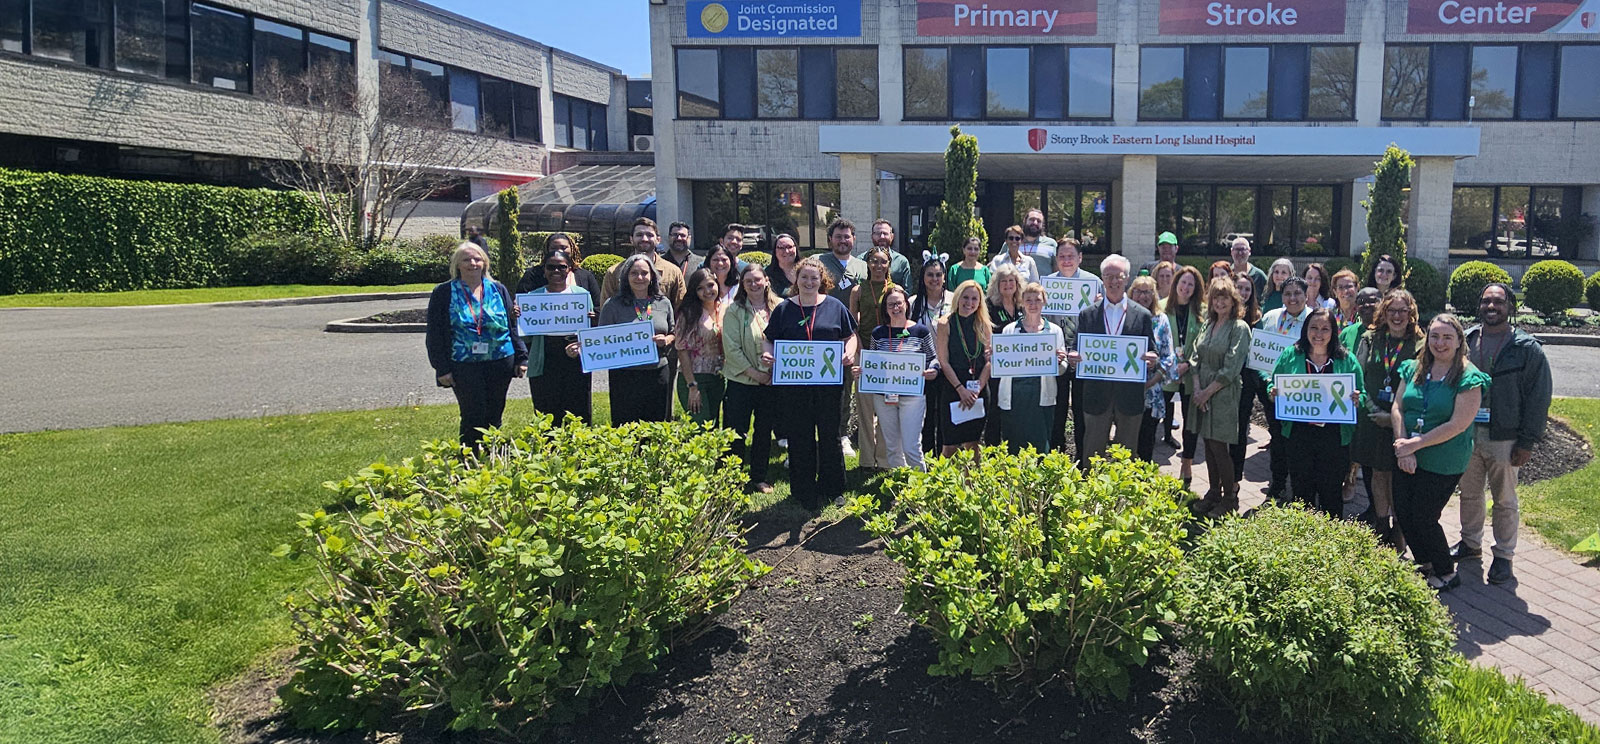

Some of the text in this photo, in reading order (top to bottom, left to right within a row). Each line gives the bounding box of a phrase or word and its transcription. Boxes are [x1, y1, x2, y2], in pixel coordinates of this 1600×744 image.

[738, 4, 835, 14] Joint Commission
[1206, 2, 1298, 26] Stroke
[1438, 1, 1537, 24] Center
[954, 4, 1059, 33] Primary
[738, 15, 837, 35] Designated
[1051, 134, 1255, 147] Stony Brook Eastern Long Island Hospital
[1046, 281, 1073, 290] LOVE
[1046, 292, 1074, 300] YOUR
[521, 301, 585, 312] Be Kind To
[1045, 303, 1072, 311] MIND
[524, 315, 584, 326] Your Mind
[584, 331, 649, 347] Be Kind To
[1085, 339, 1117, 350] LOVE
[781, 345, 814, 355] LOVE
[995, 342, 1054, 353] Be Kind To
[1253, 339, 1286, 352] Be Kin
[588, 345, 650, 362] Your Mind
[1084, 352, 1118, 363] YOUR
[1253, 352, 1275, 364] Your
[781, 358, 815, 367] YOUR
[864, 360, 921, 372] Be Kind To
[997, 356, 1052, 368] Your Mind
[780, 370, 813, 380] MIND
[1084, 366, 1116, 375] MIND
[865, 374, 919, 386] Your Mind
[1283, 379, 1321, 389] LOVE
[1284, 392, 1322, 403] YOUR
[1284, 405, 1321, 417] MIND
